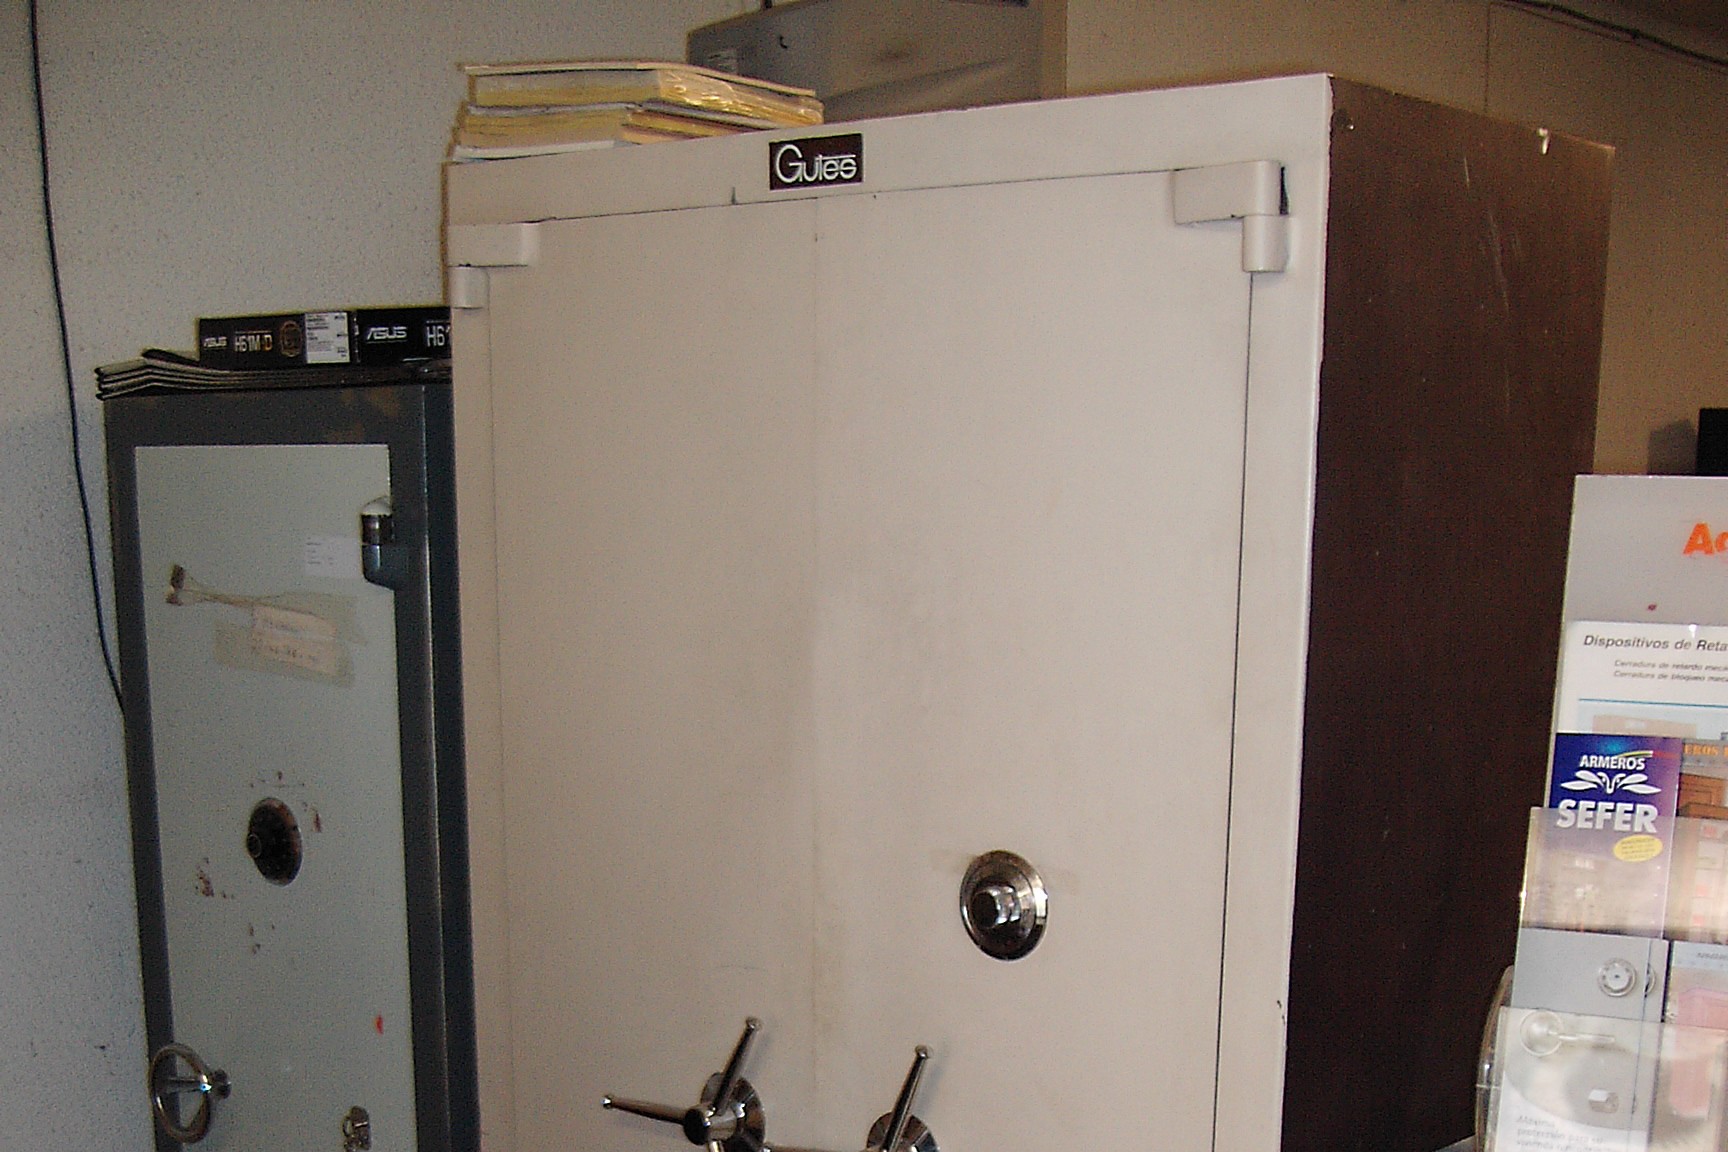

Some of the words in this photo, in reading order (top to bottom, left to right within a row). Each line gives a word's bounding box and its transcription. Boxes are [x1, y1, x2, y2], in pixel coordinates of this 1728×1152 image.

[776, 143, 857, 183] Gutes
[367, 326, 407, 340] ASUS
[203, 336, 227, 348] ASUS
[1583, 634, 1670, 650] Dispositivos
[1674, 639, 1692, 651] de
[1579, 754, 1646, 771] ARMEROS
[1556, 798, 1659, 834] SEFER
